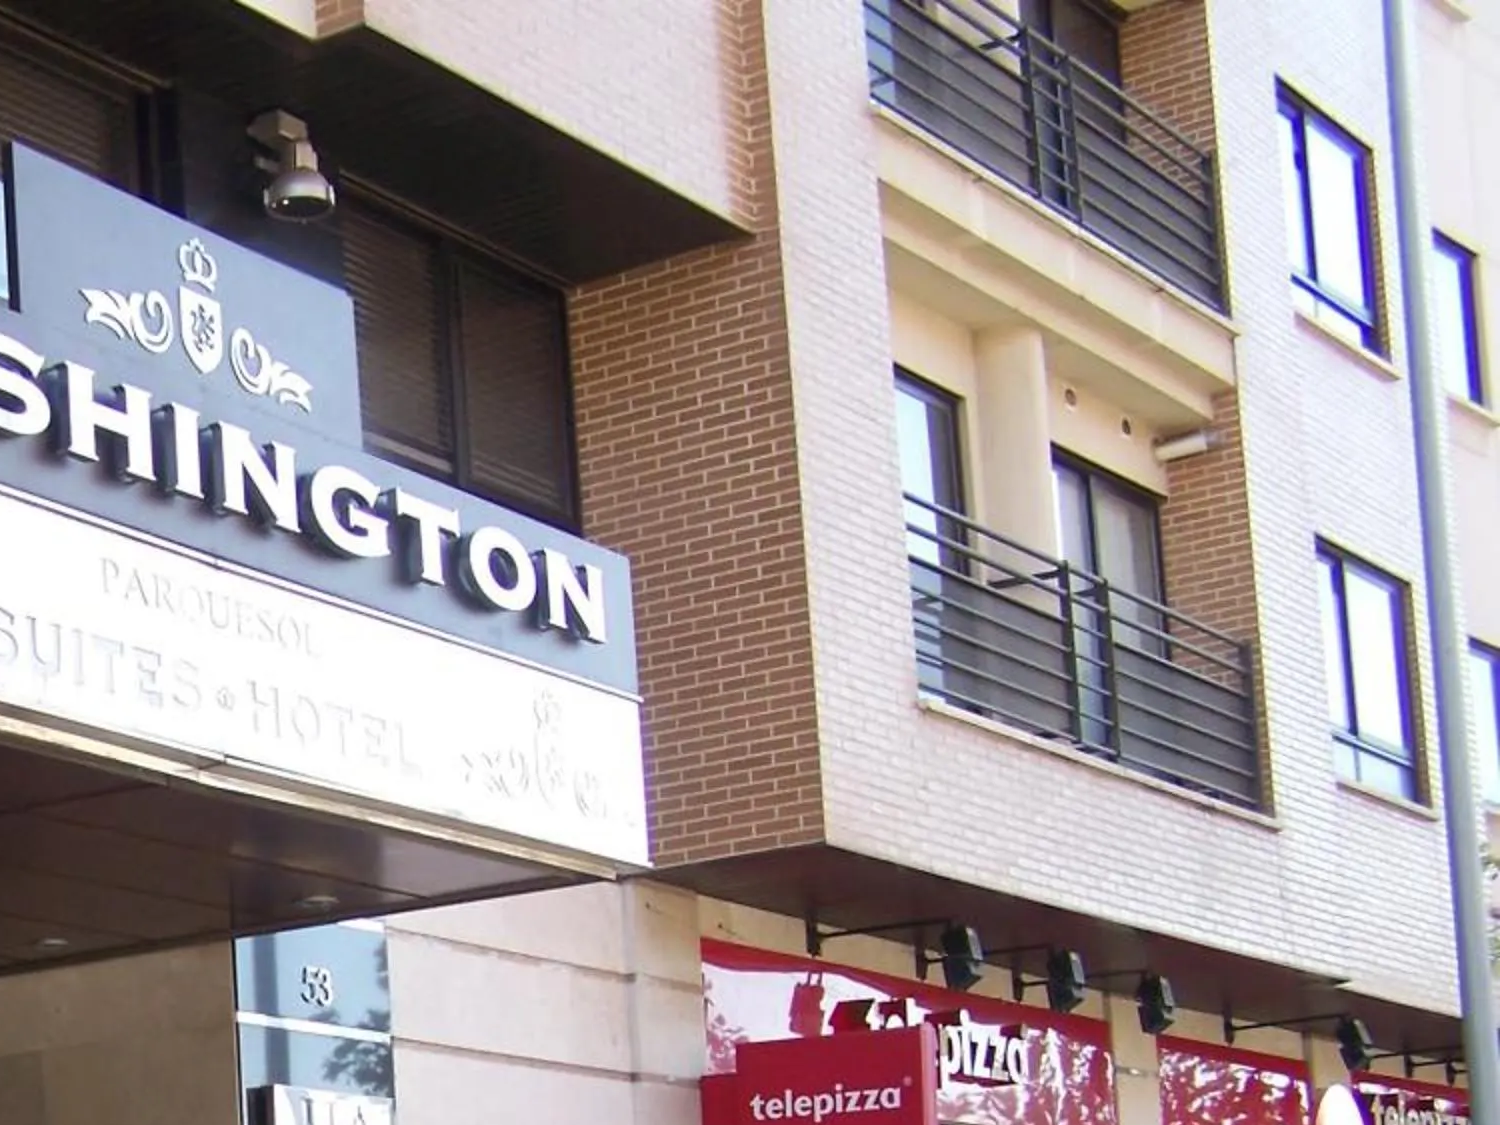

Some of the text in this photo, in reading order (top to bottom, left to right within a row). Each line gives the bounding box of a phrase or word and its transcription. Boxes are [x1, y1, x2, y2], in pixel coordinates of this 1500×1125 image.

[100, 556, 323, 661] PARQUESOL
[247, 679, 422, 780] HOTEL
[300, 965, 332, 1008] 53
[750, 1083, 901, 1123] telepizza
